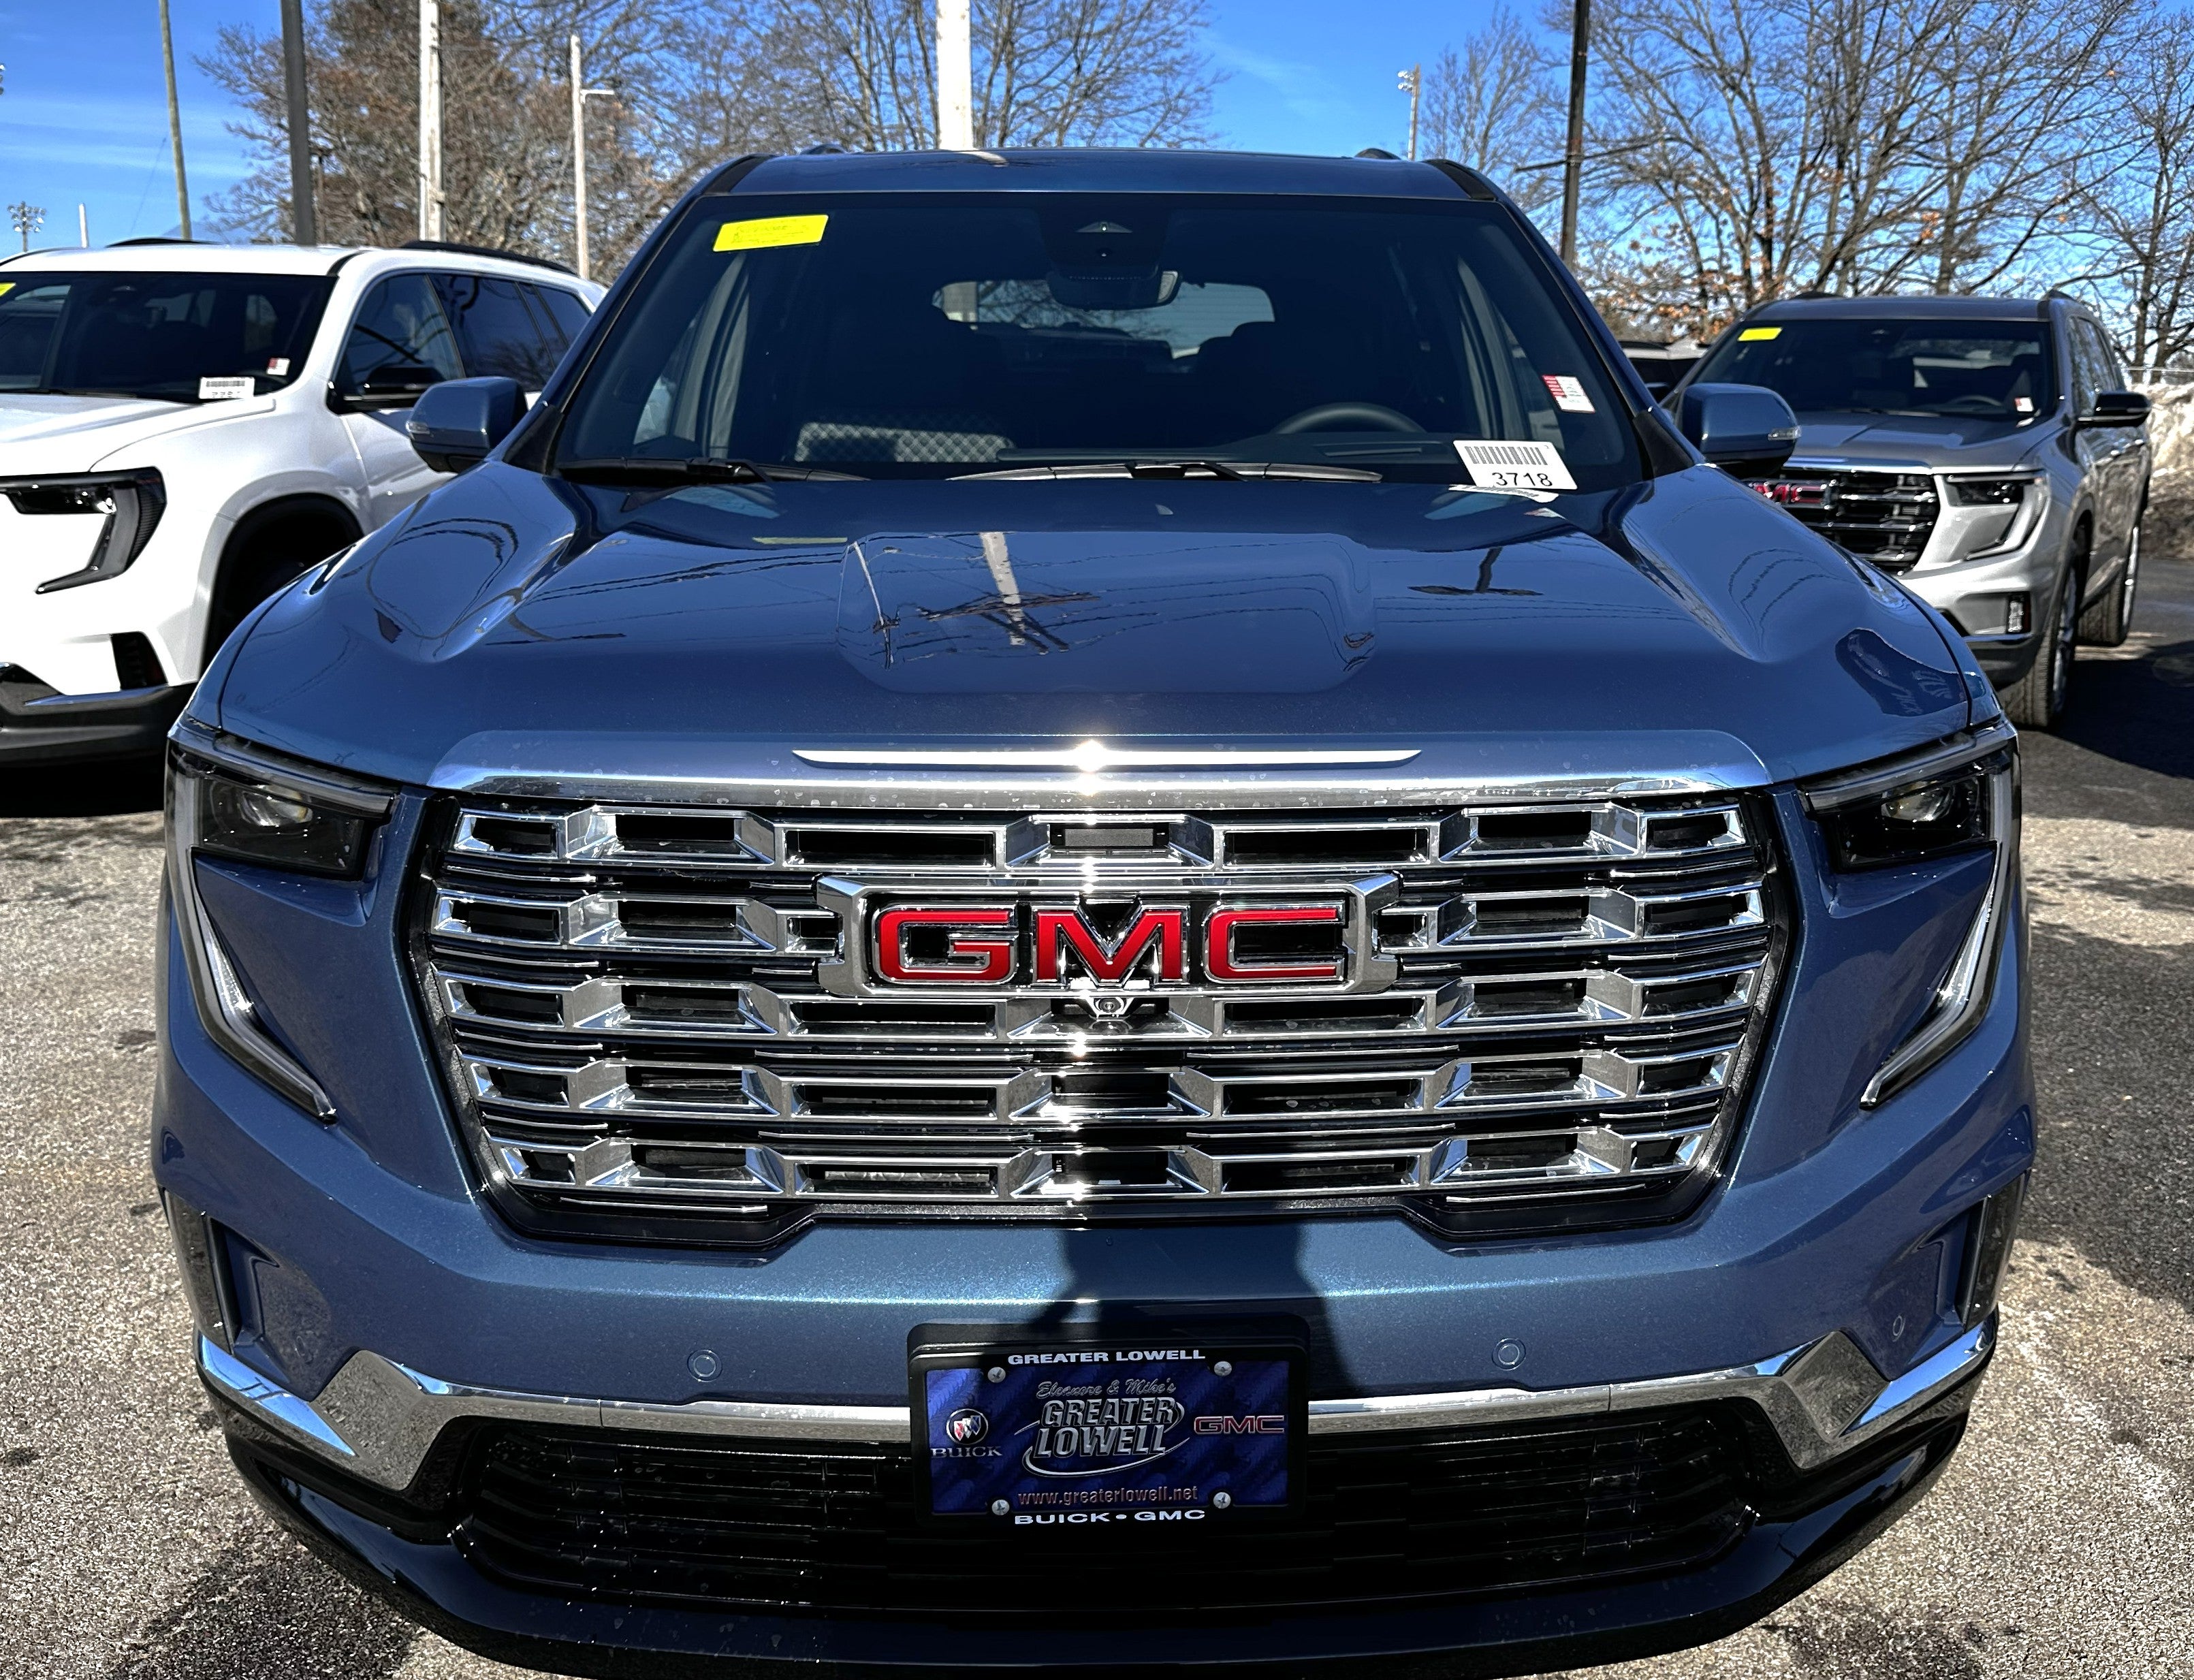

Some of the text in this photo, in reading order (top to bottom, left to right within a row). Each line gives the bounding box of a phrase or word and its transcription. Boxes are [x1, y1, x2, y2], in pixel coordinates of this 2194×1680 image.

[1491, 472, 1553, 487] 3718
[1752, 482, 1828, 504] MC
[873, 904, 1346, 986] GMC
[1007, 1349, 1206, 1365] GREATER LOWELL
[1107, 1379, 1120, 1395] &
[1125, 1377, 1177, 1395] Mike's
[1041, 1397, 1177, 1427] GREATER
[1194, 1415, 1285, 1434] GMC
[1033, 1424, 1166, 1459] LOWELL
[930, 1446, 1003, 1458] BUICK
[1018, 1485, 1198, 1506] www.greaterlowell.net
[1014, 1509, 1206, 1525] BUICK GMC
